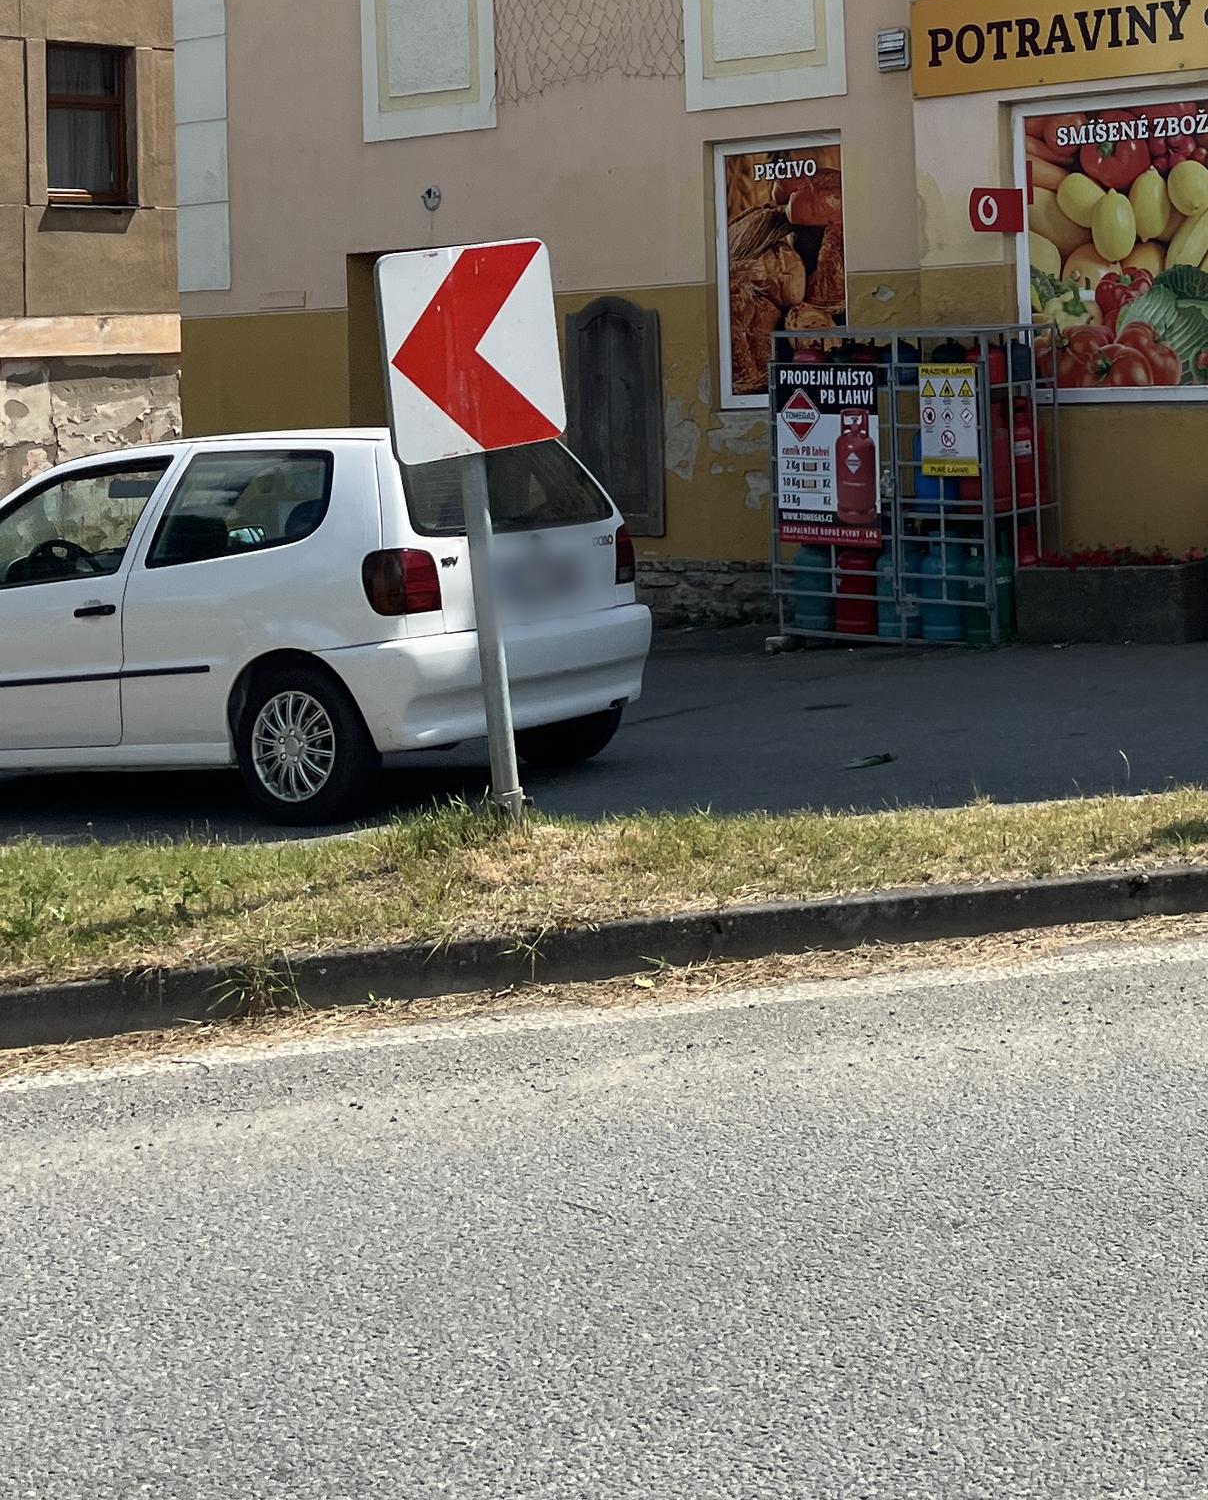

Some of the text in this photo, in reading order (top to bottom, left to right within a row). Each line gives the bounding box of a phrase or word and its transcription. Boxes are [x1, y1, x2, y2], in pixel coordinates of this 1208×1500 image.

[1056, 114, 1149, 147] SMÍŠENÉ
[754, 158, 817, 181] PEČIVO
[779, 367, 873, 386] PRODEJNÍ MÍSTO
[820, 387, 874, 405] PB LAHVÍ
[784, 411, 816, 420] TOMEGAS
[782, 445, 830, 457] ceník PB lahví
[786, 460, 791, 469] 2
[791, 460, 800, 472] Kg
[822, 461, 831, 471] Kč
[783, 477, 790, 486] 10
[791, 477, 800, 489] Kg
[822, 479, 831, 488] Kč
[782, 494, 832, 507] 33 Kg Kč
[841, 529, 860, 538] PLYNY
[865, 530, 878, 539] LPG
